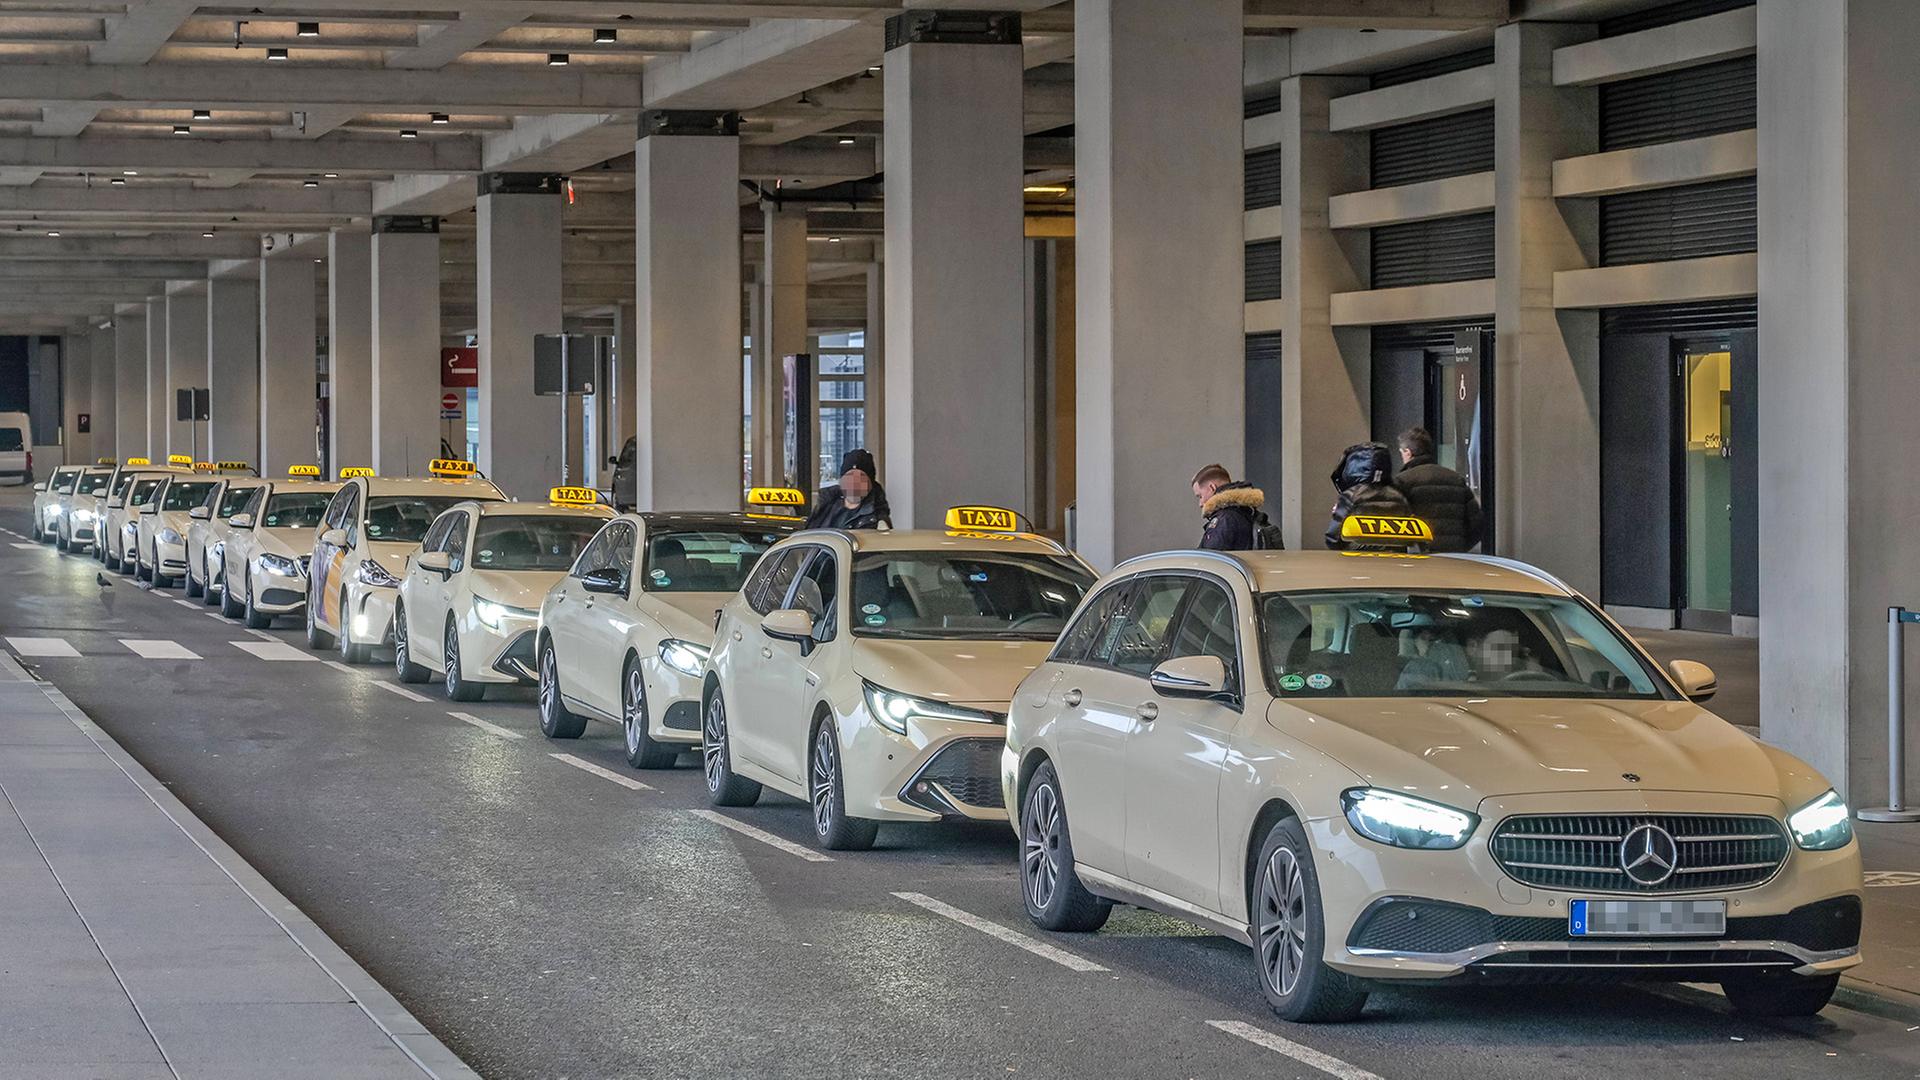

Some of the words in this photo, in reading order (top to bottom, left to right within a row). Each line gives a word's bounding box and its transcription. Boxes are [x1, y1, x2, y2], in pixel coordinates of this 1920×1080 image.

[81, 416, 87, 424] P
[438, 460, 469, 471] TAXI
[345, 469, 370, 477] TAXI
[560, 489, 590, 500] TAXI
[759, 491, 797, 502] TAXI
[962, 510, 1007, 526] TAXI
[1360, 518, 1420, 535] TAXI
[1575, 920, 1581, 929] D
